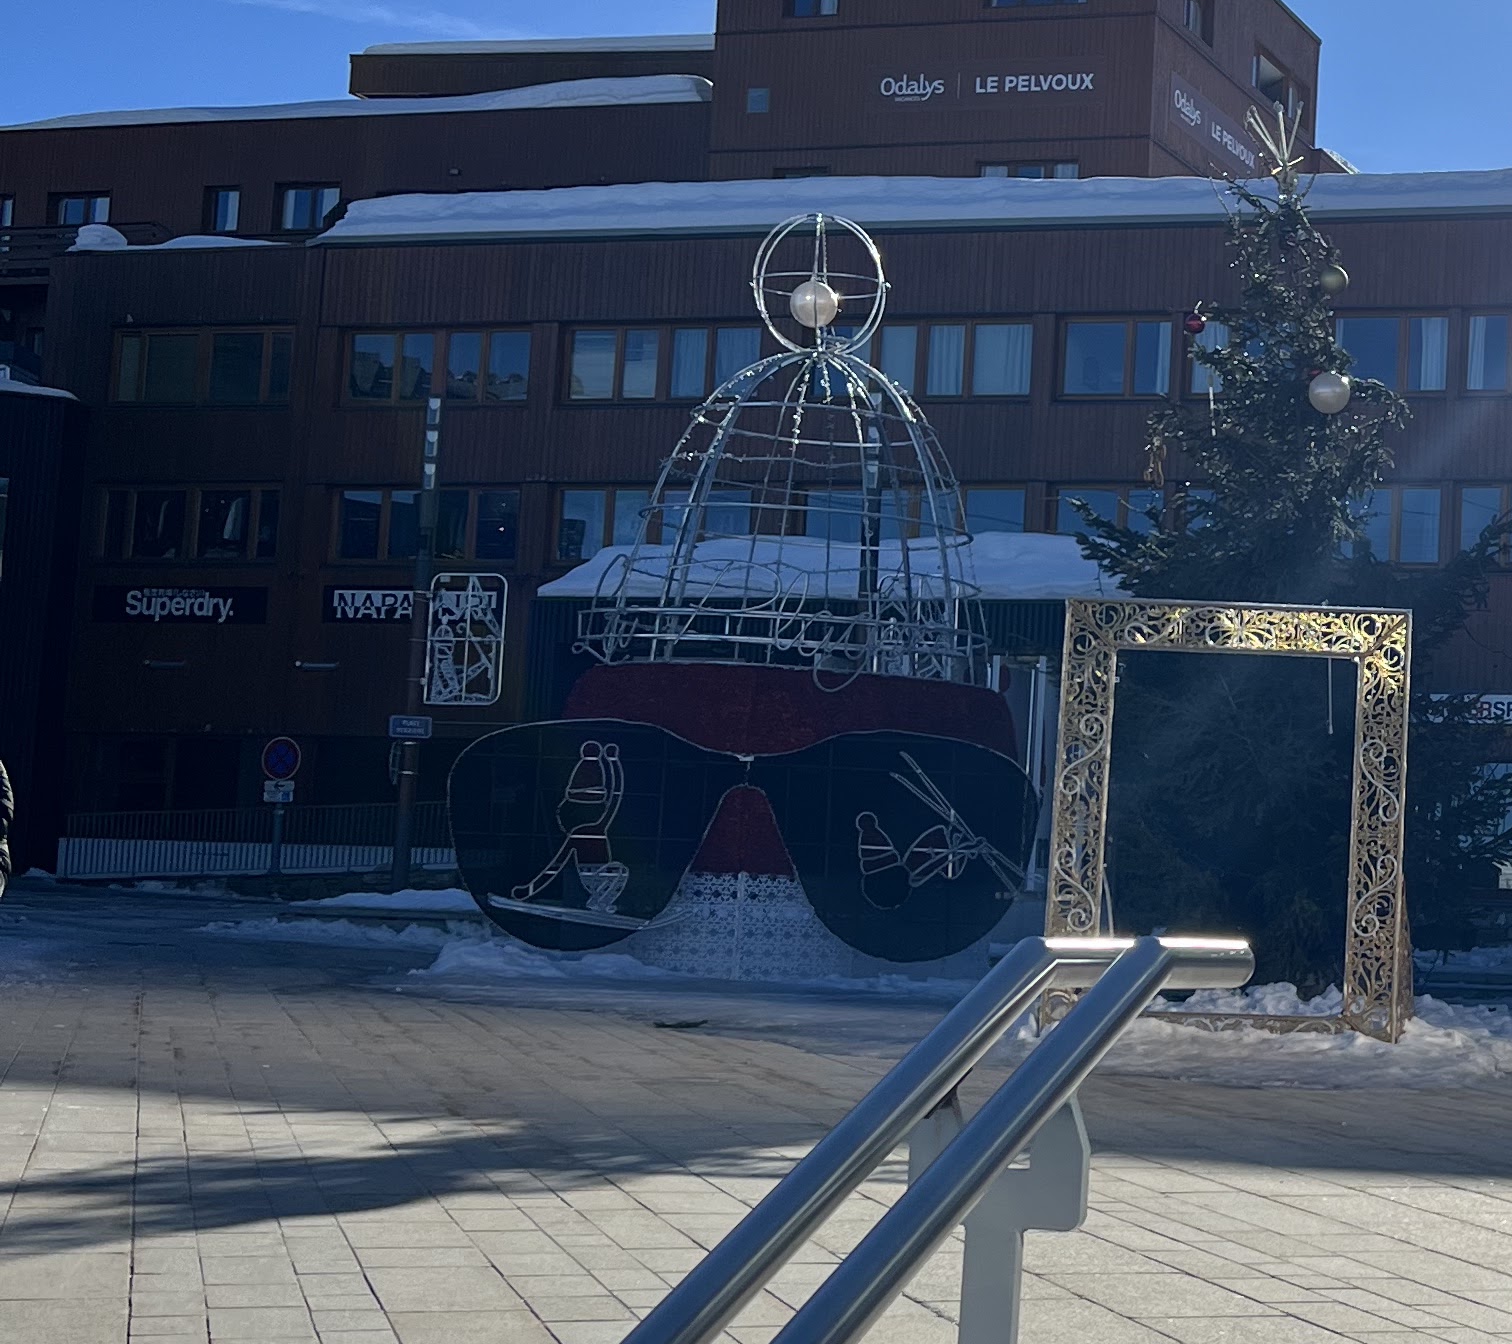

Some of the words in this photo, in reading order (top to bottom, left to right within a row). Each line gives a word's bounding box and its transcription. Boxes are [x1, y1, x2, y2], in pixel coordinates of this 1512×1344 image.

[880, 73, 945, 102] Odalys
[975, 76, 999, 94] LE
[1004, 73, 1095, 93] PELVOUX
[1174, 89, 1202, 127] Odalys
[1211, 121, 1222, 142] LE
[1222, 130, 1256, 169] PELVOUX
[125, 590, 234, 624] Superdry.
